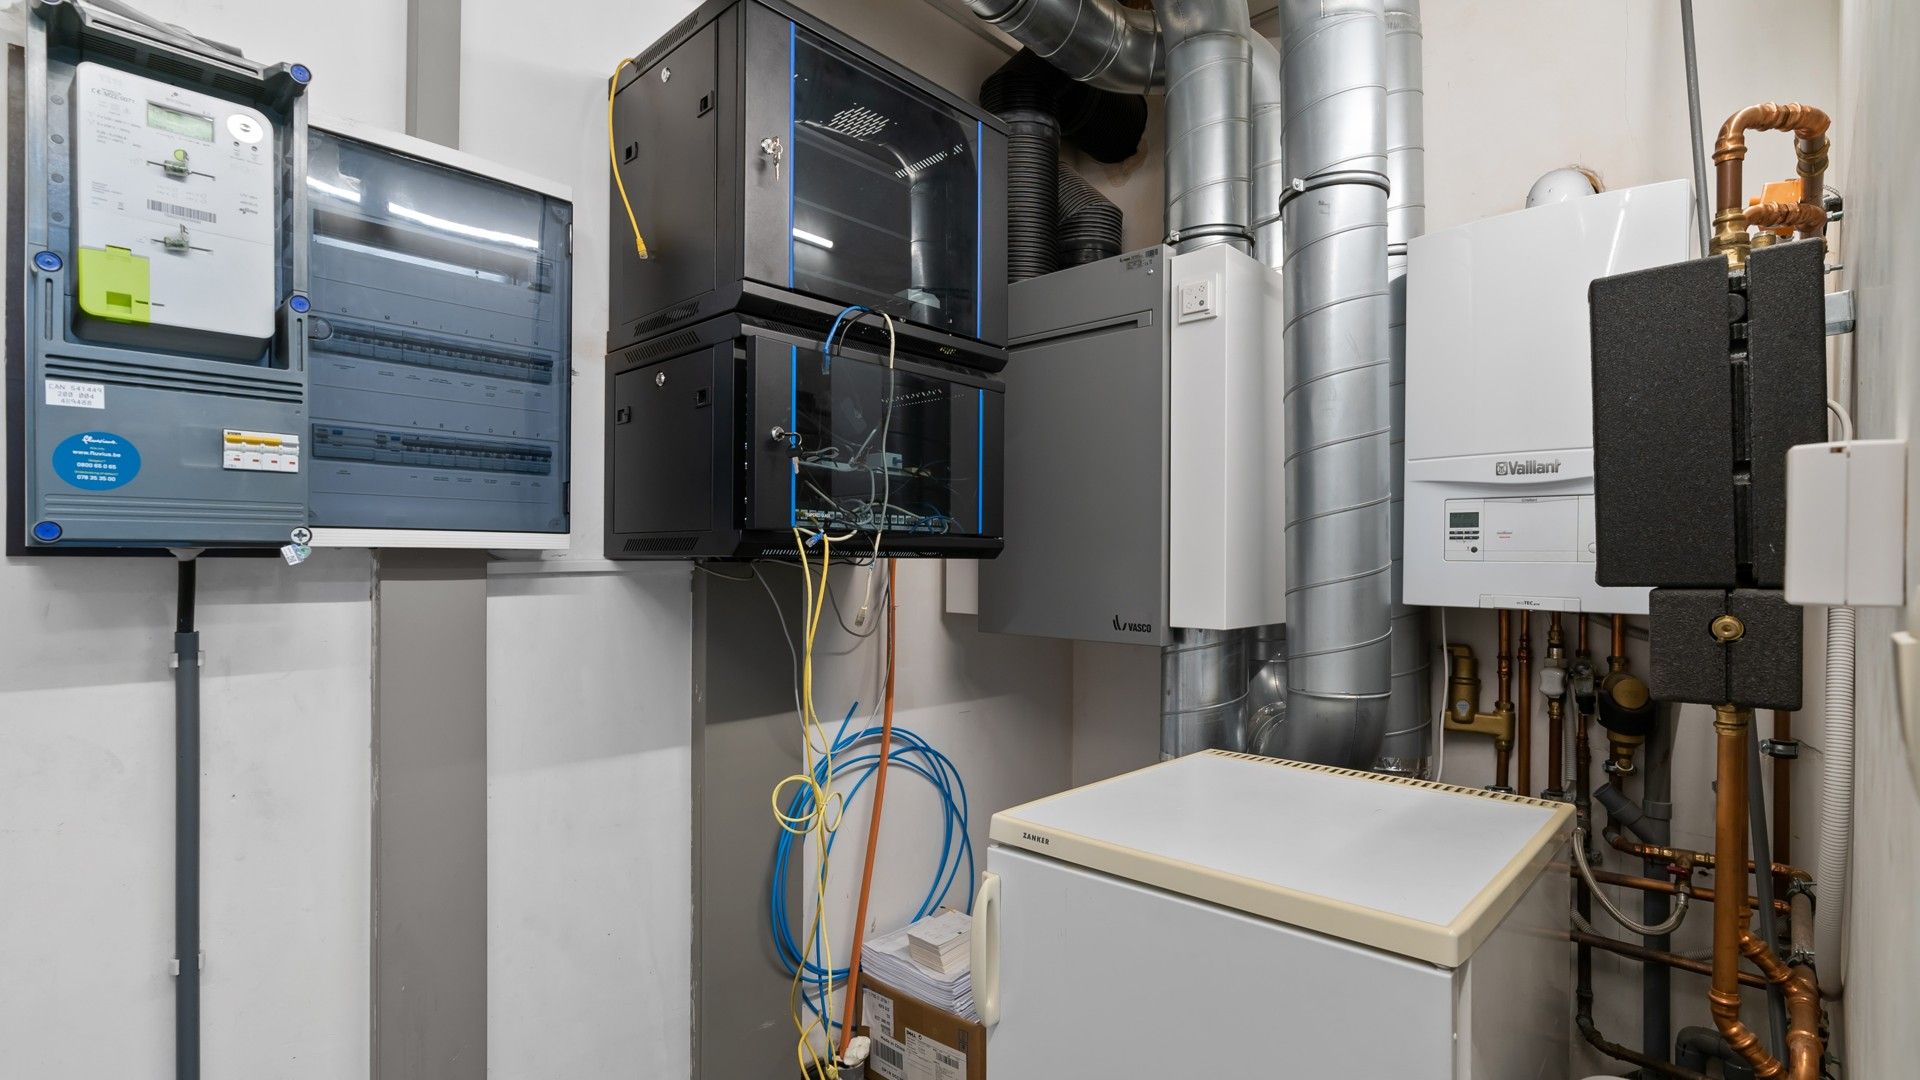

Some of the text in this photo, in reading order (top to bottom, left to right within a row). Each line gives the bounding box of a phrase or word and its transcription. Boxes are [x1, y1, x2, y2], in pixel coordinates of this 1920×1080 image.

[1508, 460, 1561, 475] Vaillant
[1128, 622, 1152, 633] VASCO
[1022, 832, 1050, 845] ZANKER
